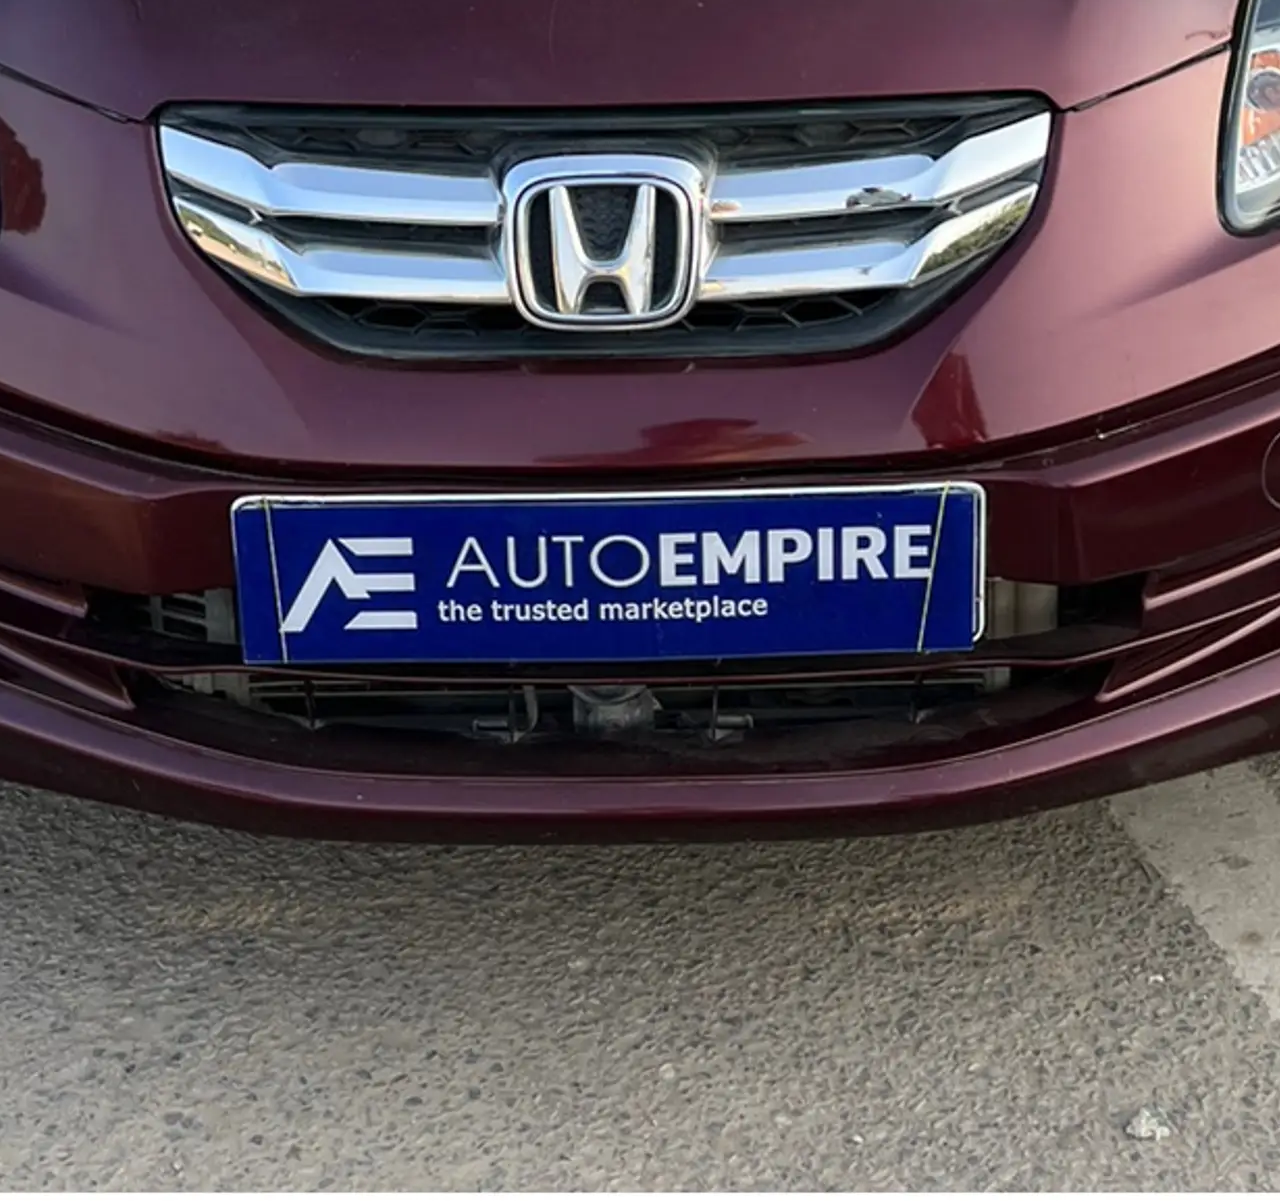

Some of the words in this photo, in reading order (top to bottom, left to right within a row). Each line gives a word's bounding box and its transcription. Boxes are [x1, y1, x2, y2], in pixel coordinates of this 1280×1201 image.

[447, 524, 932, 588] AUTOEMPIRE
[438, 599, 482, 621] the
[492, 598, 589, 621] trusted
[600, 595, 768, 622] marketplace
